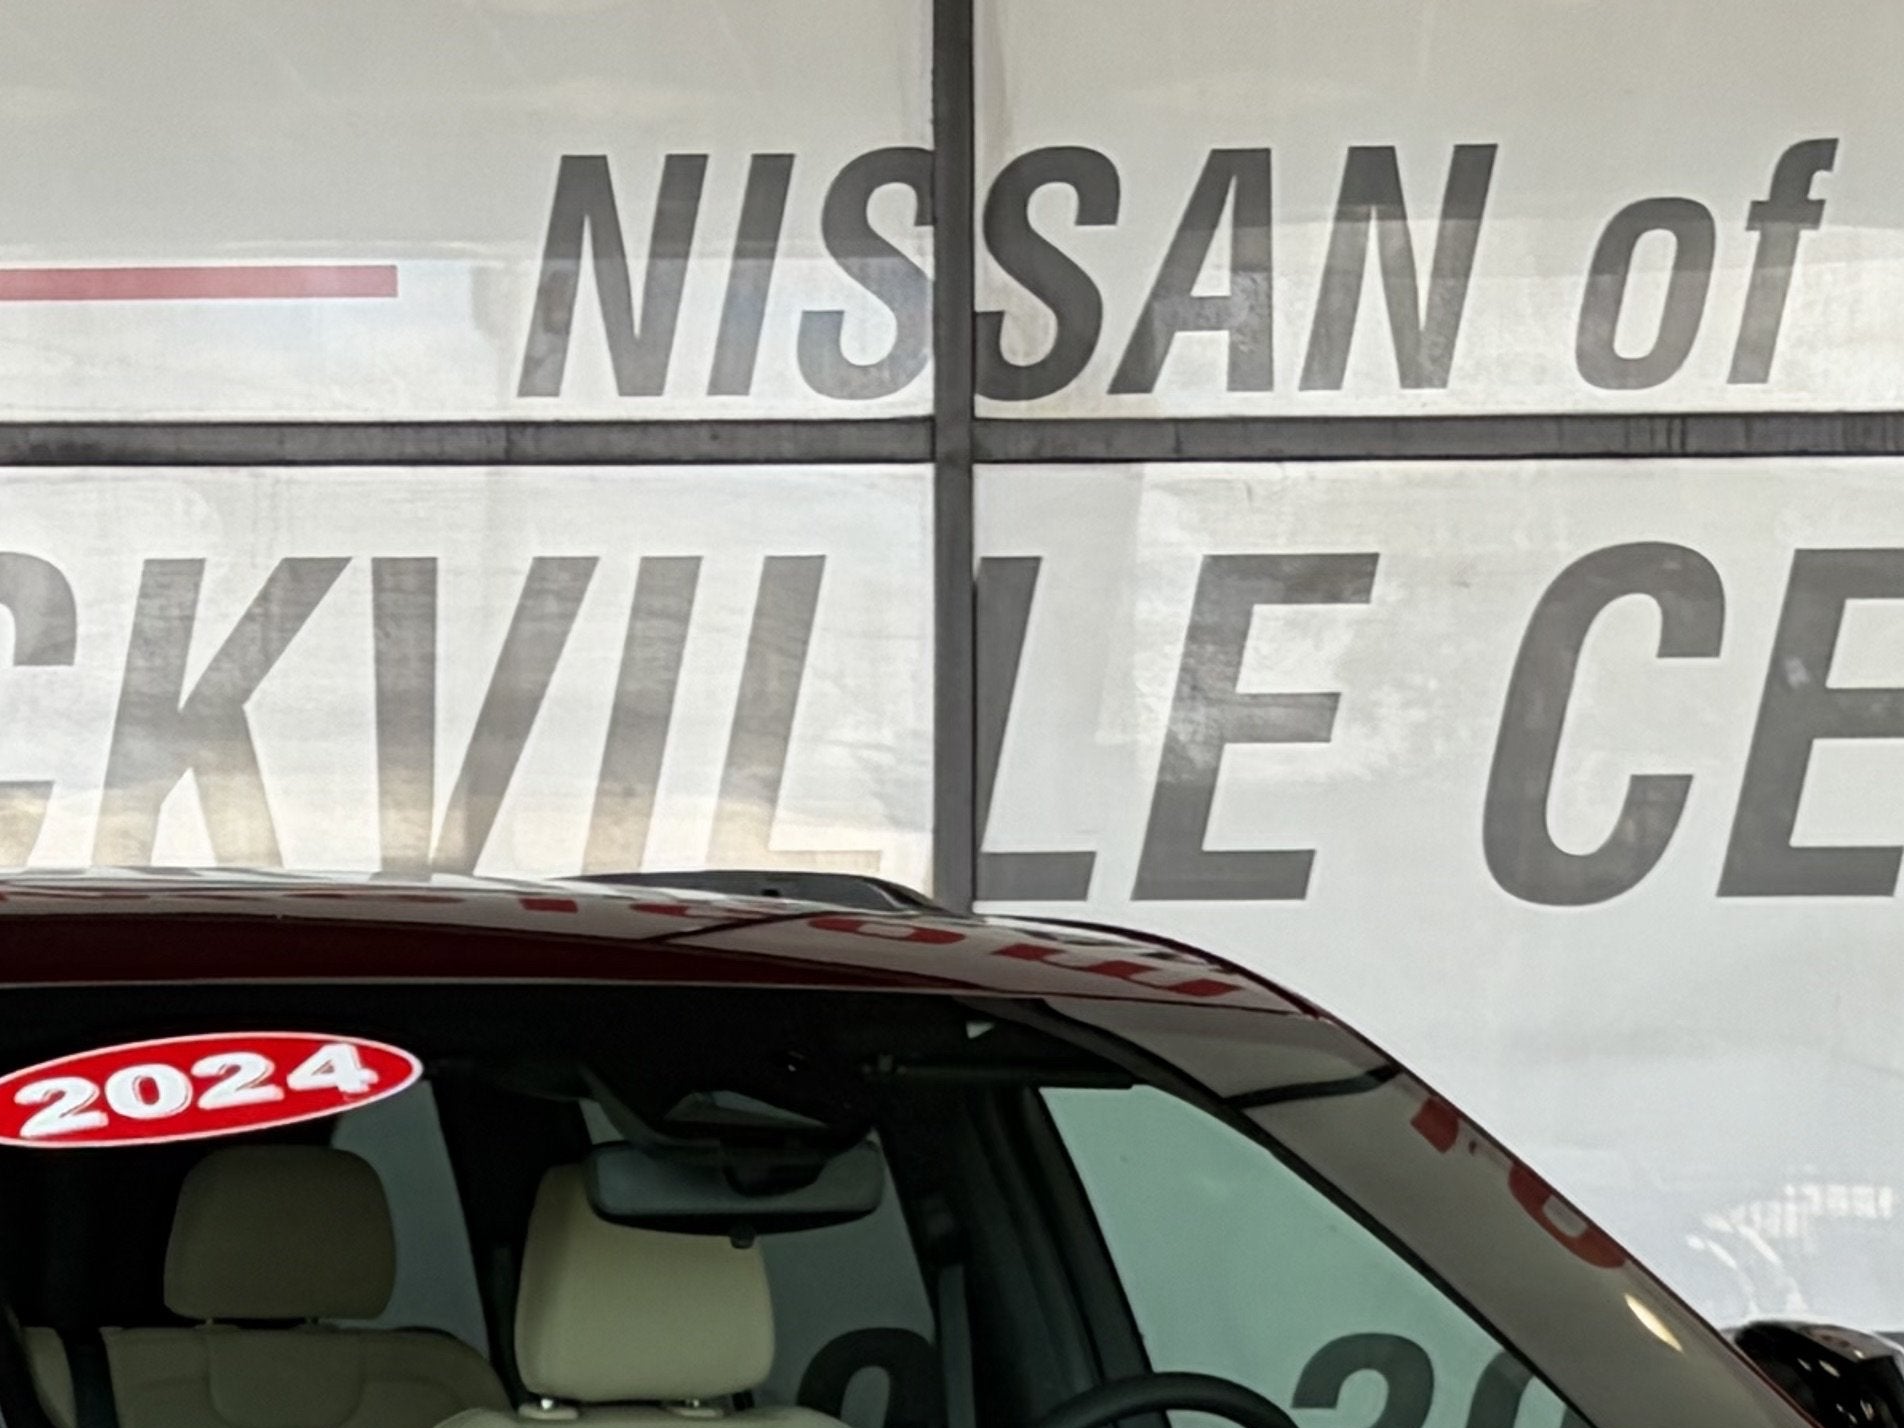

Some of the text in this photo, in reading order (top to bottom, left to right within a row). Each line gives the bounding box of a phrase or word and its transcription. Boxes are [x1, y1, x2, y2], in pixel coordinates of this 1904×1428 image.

[516, 138, 1839, 401] NISSAN of
[14, 1043, 379, 1138] 2024
